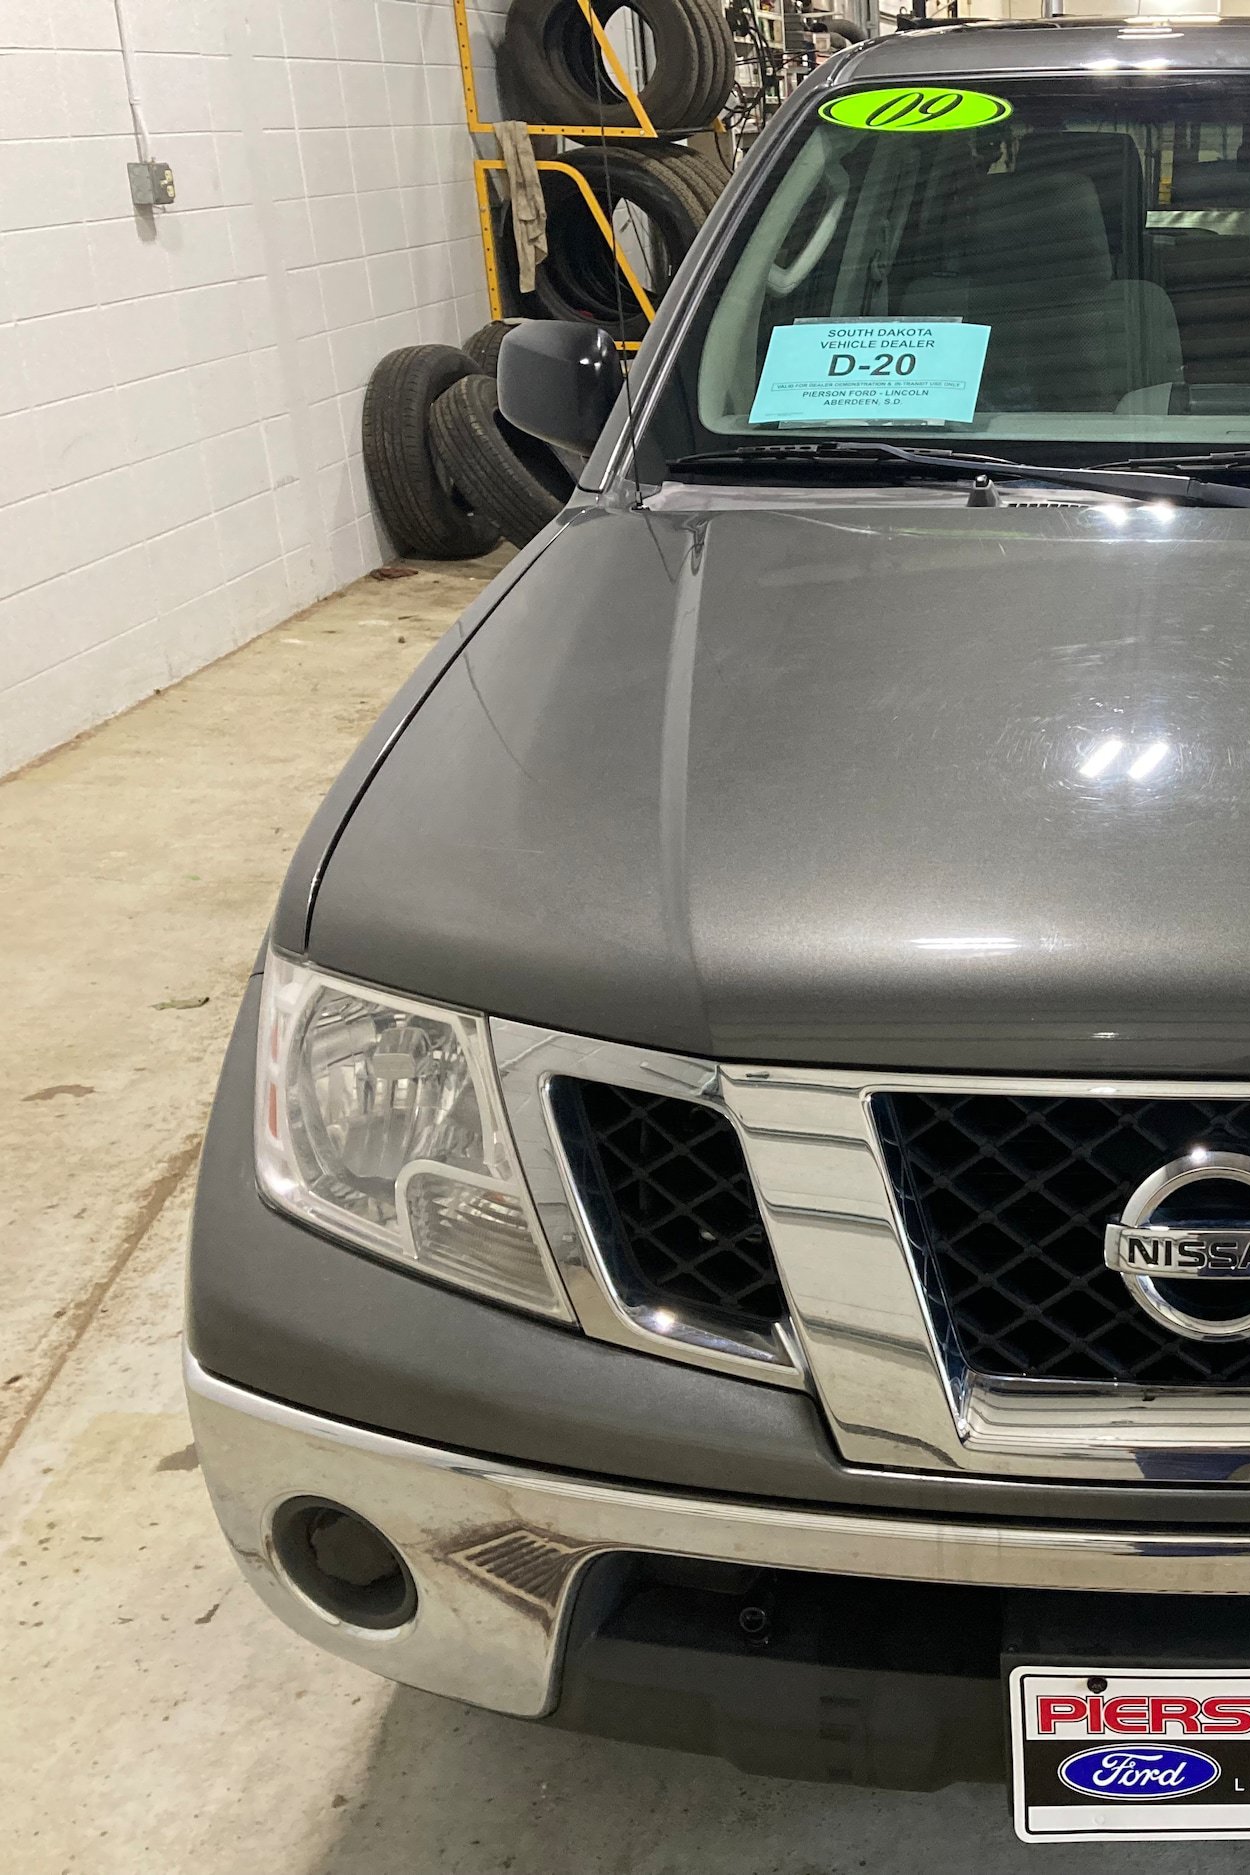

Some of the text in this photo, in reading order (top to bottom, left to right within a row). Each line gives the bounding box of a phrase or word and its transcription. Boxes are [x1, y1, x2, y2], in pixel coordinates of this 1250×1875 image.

[865, 91, 964, 128] 09
[827, 328, 933, 338] SOUTH DAKOTA
[820, 340, 935, 349] VEHICLE DEALER
[827, 353, 917, 377] D-20
[802, 390, 847, 398] PIERSON
[848, 389, 877, 397] FORD
[884, 389, 930, 397] LINCOLN
[823, 398, 880, 407] ABERDEEN,
[1093, 1748, 1189, 1788] Ford
